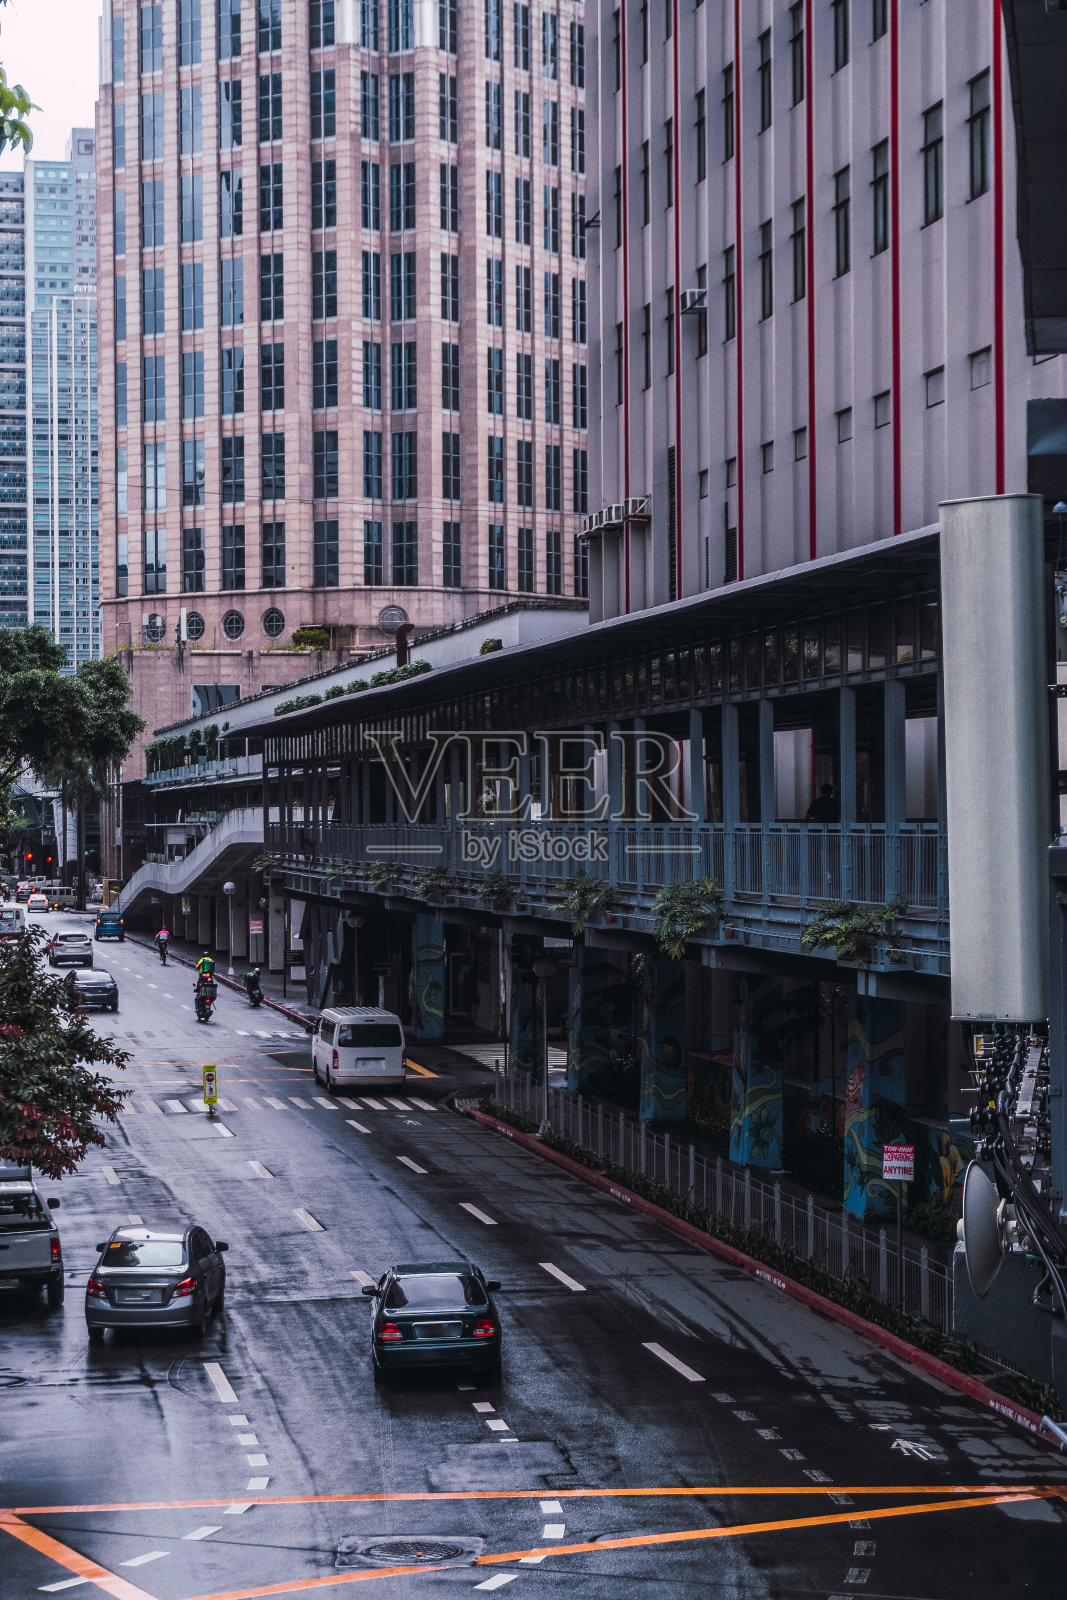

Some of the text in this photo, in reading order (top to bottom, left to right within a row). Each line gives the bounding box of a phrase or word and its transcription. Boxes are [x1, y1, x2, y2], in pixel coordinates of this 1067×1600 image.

[883, 1145, 913, 1153] TOW-AWAY
[883, 1153, 914, 1162] NO PARKING
[883, 1165, 914, 1175] ANYTIME
